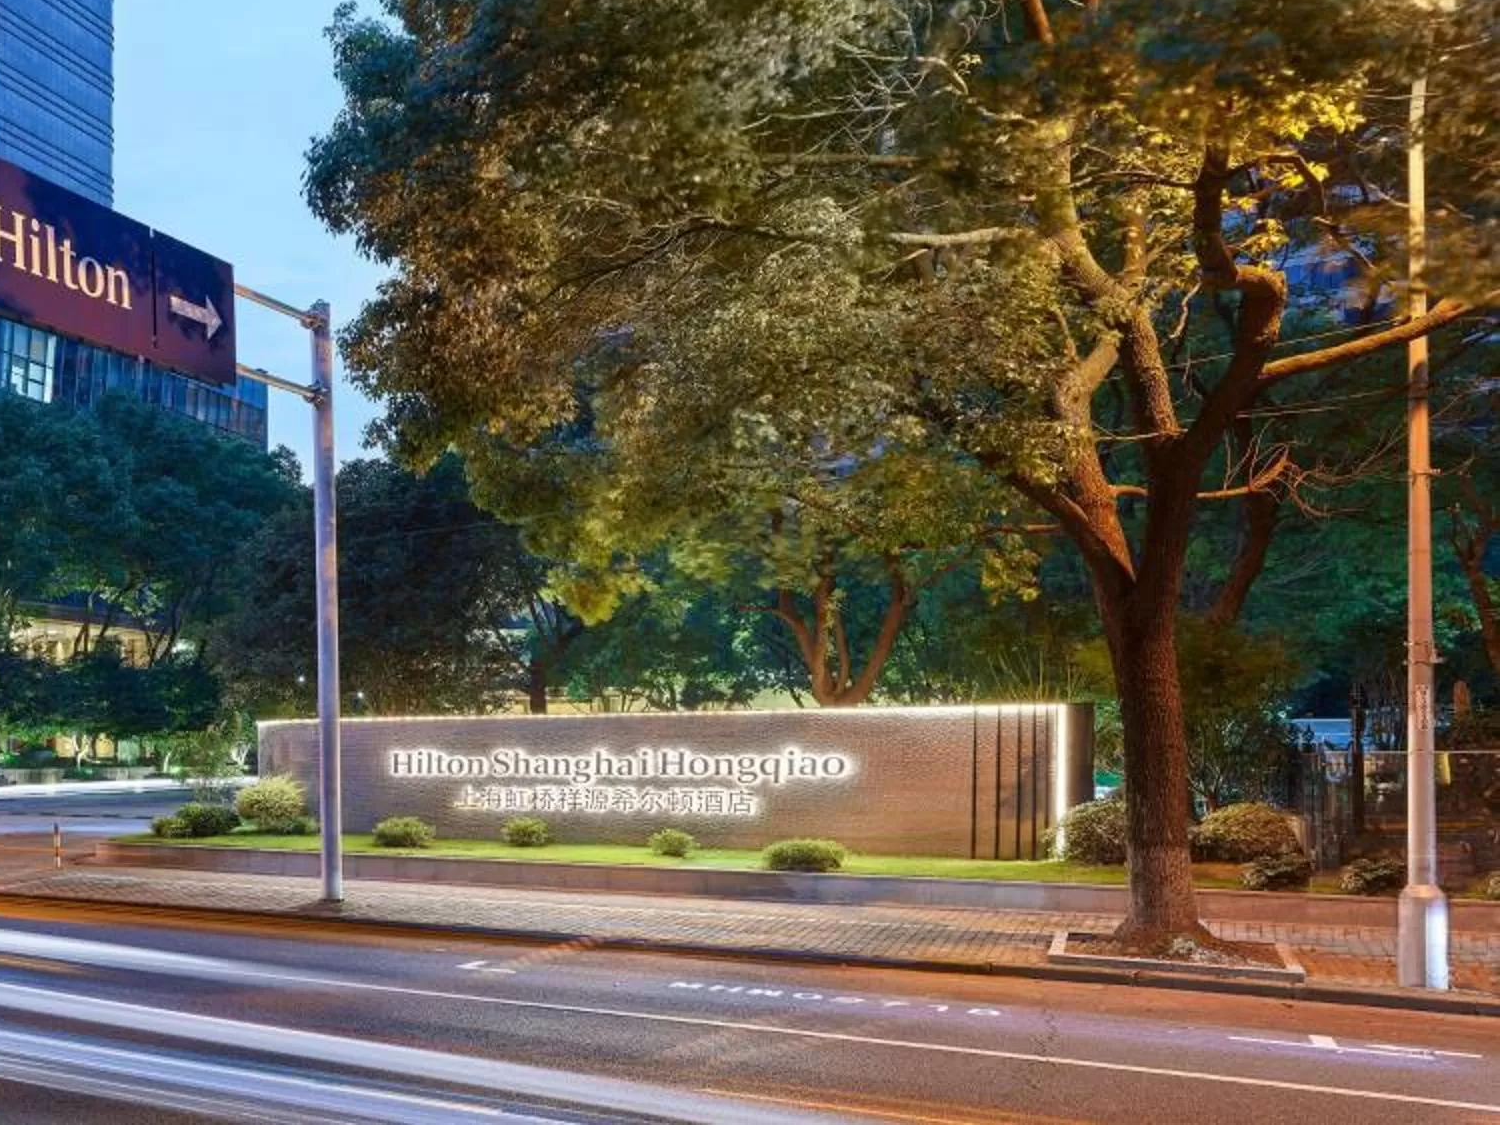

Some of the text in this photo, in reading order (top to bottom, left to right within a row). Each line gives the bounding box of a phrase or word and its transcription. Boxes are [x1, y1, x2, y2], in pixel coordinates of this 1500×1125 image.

[391, 749, 846, 786] Hilton Shanghai Hongqiao
[453, 785, 754, 814] 上海虹桥祥源希尔顿酒店
